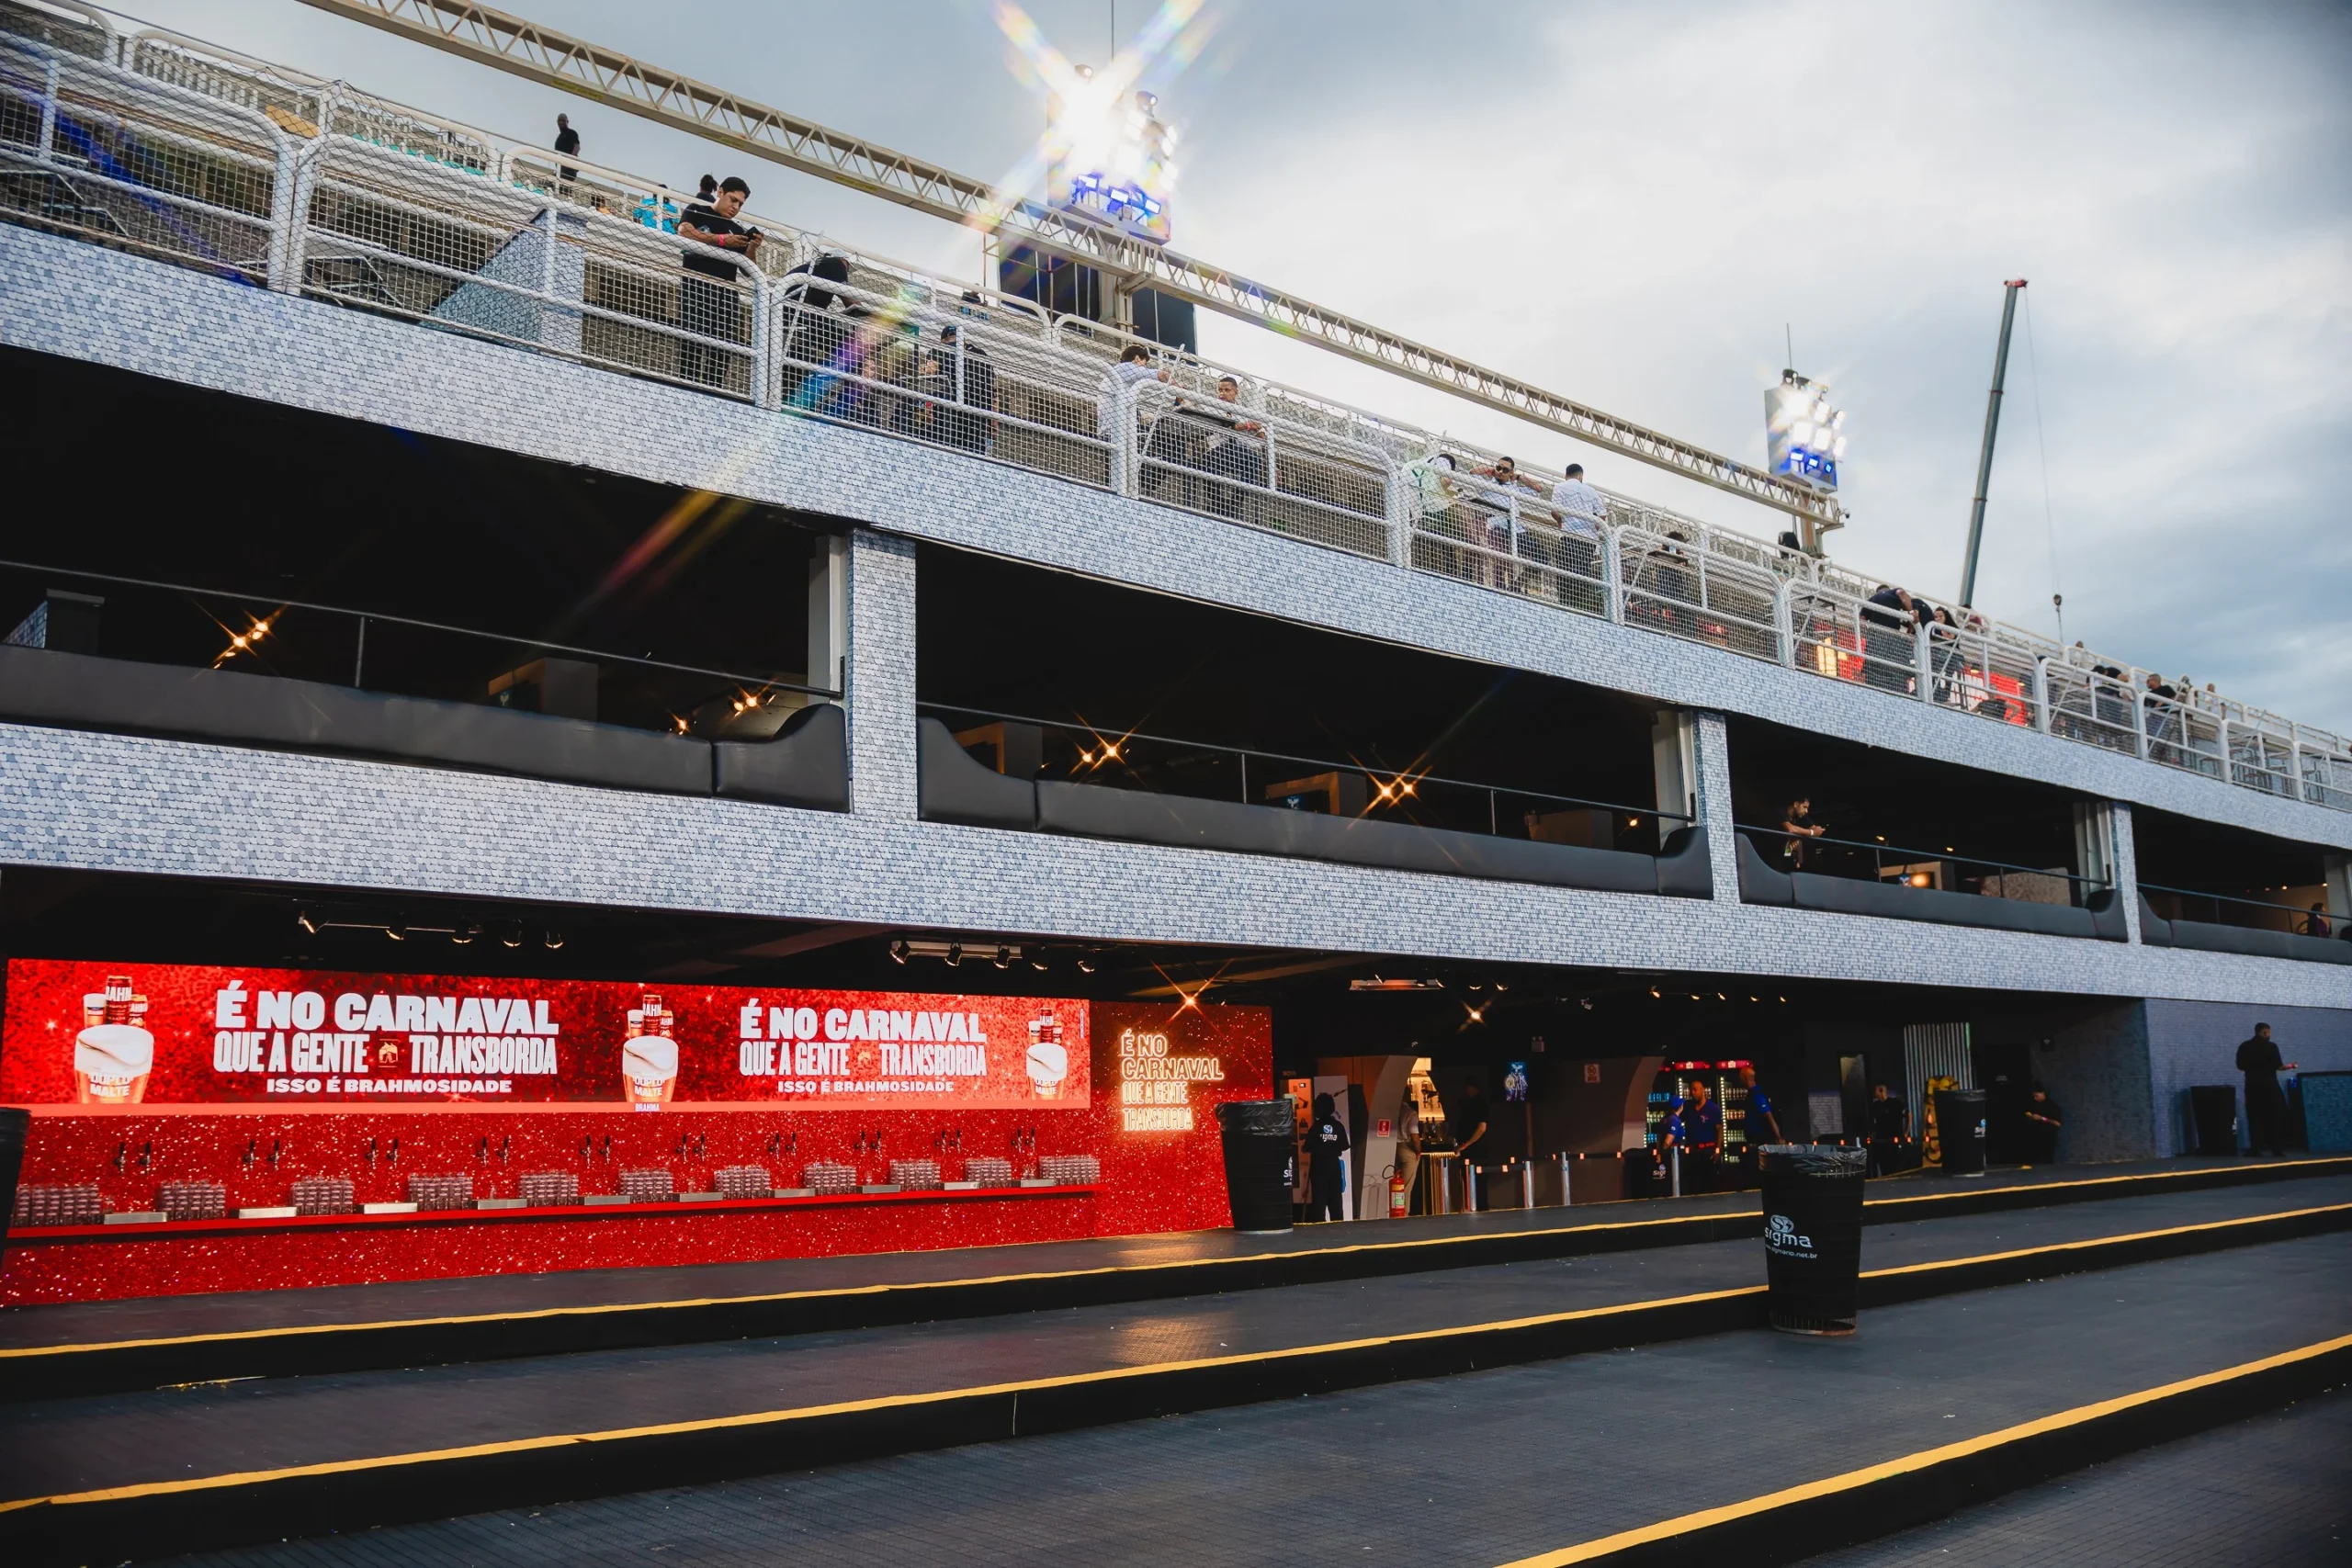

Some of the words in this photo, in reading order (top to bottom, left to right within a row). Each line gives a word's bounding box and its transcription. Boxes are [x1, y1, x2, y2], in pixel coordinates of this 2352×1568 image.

[215, 980, 247, 1029] É
[256, 990, 325, 1031] NO
[334, 992, 560, 1034] CARNAVAL
[740, 998, 762, 1039] É
[769, 1007, 818, 1040] NO
[824, 1008, 988, 1043] CARNAVAL
[213, 1030, 266, 1073] QUE
[268, 1032, 288, 1073] A
[291, 1032, 369, 1074] GENTE
[409, 1035, 559, 1075] TRANSBORDA
[1121, 1029, 1135, 1056] É
[1137, 1034, 1168, 1057] NO
[739, 1041, 776, 1077] QUE
[778, 1042, 792, 1076] A
[795, 1042, 851, 1077] GENTE
[878, 1043, 988, 1077] TRANSBORDA
[1122, 1057, 1225, 1080] CARNAVAL
[89, 1083, 130, 1098] MALTE
[266, 1078, 322, 1093] ISSO
[326, 1076, 340, 1093] É
[345, 1078, 513, 1093] BRAHMOSIDADE
[634, 1085, 662, 1098] MALTE
[778, 1080, 817, 1093] ISSO
[820, 1078, 831, 1093] É
[833, 1081, 955, 1093] BRAHMOSIDADE
[1122, 1081, 1144, 1104] QUE
[1145, 1081, 1154, 1104] A
[1154, 1081, 1189, 1104] GENTE
[635, 1103, 661, 1112] BRAHMA
[1123, 1107, 1193, 1131] TRANSBORDA
